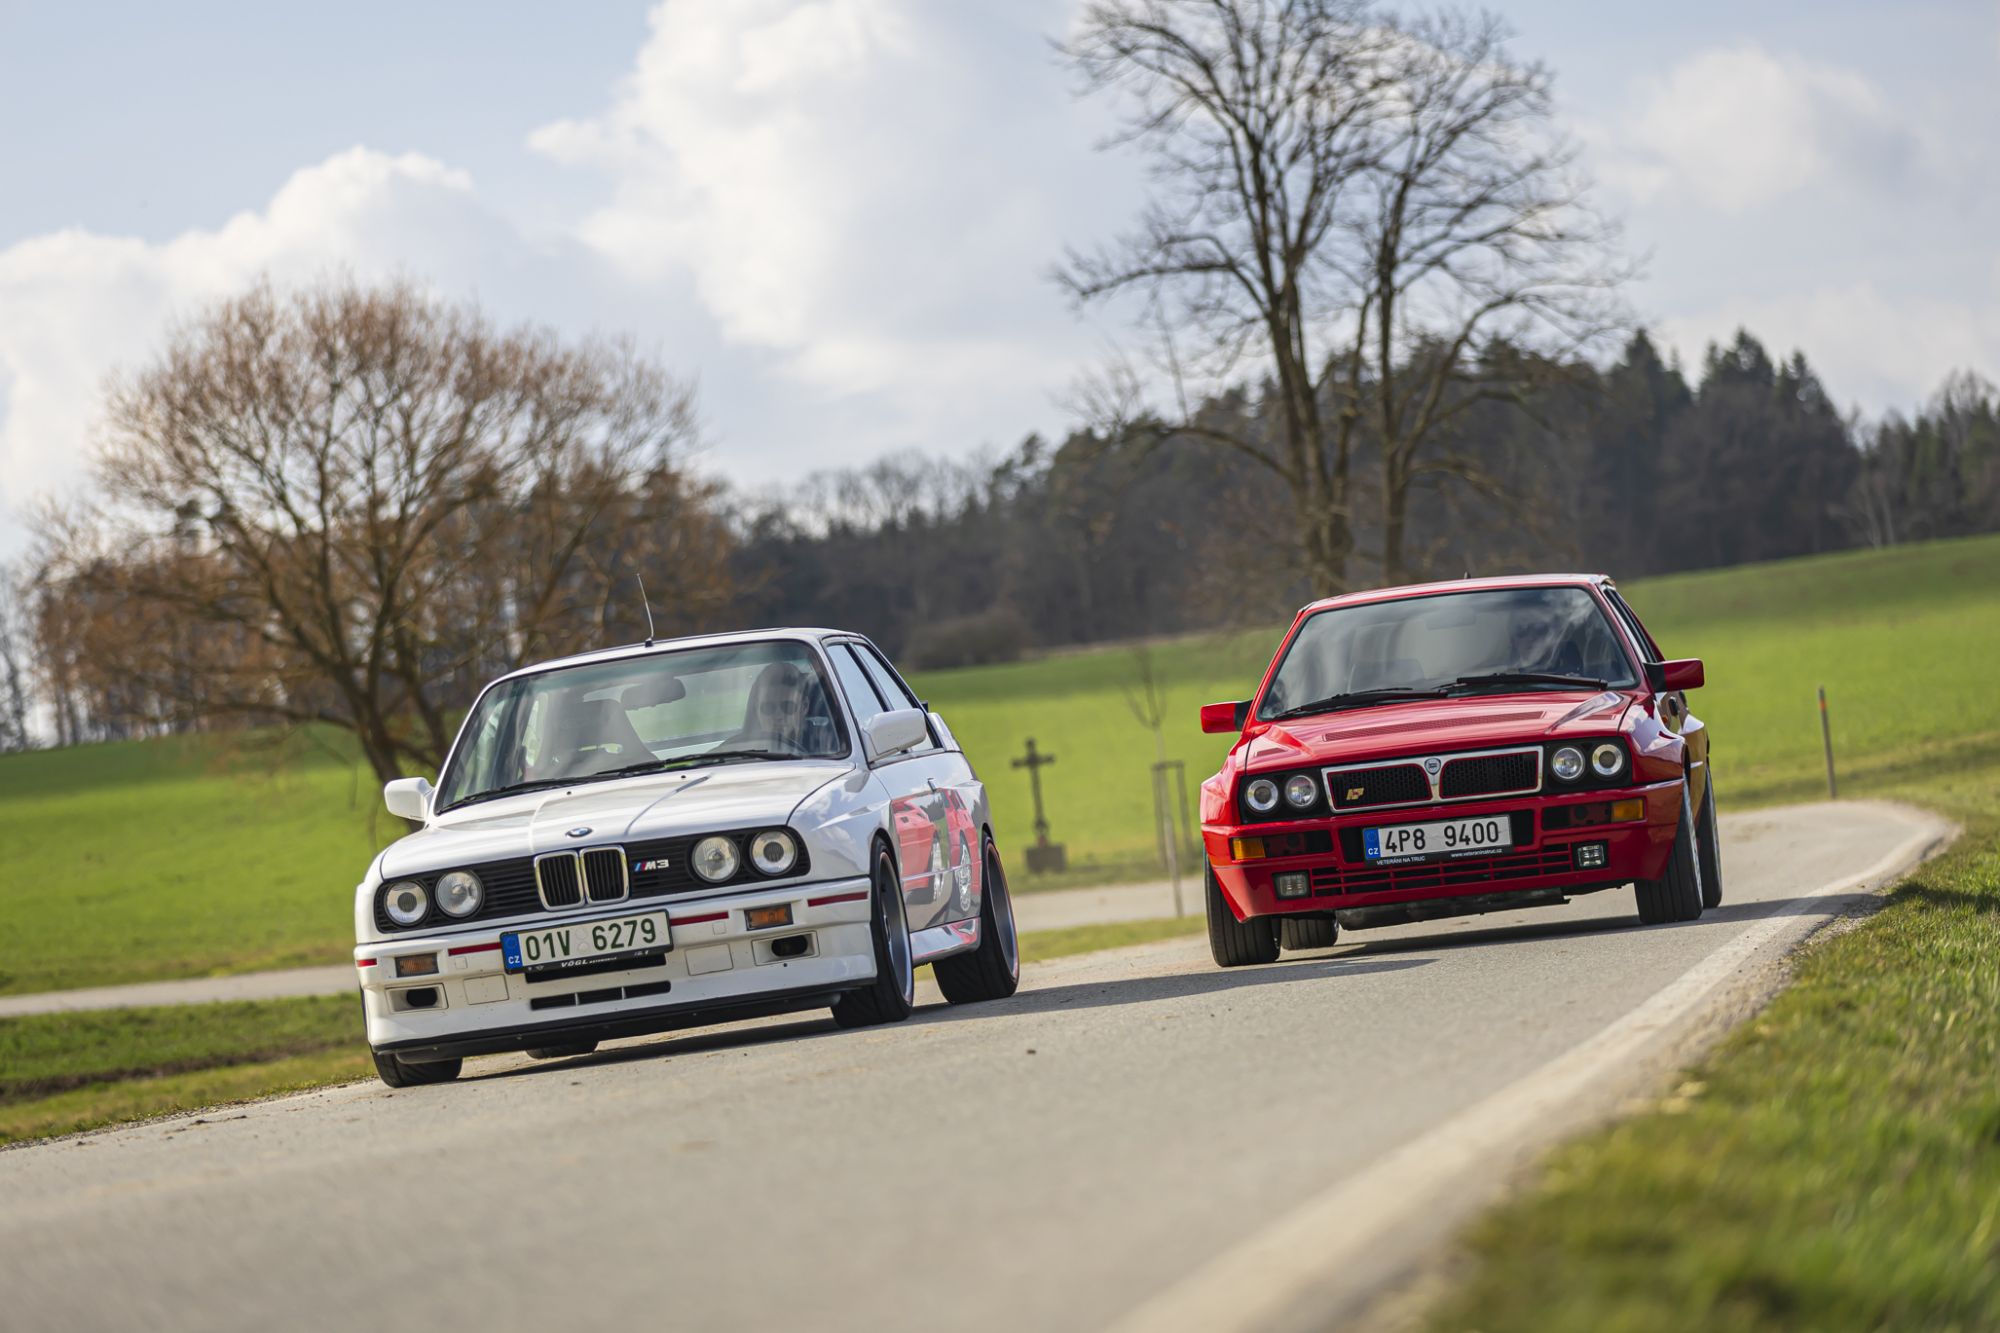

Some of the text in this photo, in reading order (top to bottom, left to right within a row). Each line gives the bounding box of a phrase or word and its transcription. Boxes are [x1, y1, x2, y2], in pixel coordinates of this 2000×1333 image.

[1385, 821, 1499, 853] 4P8 9400
[1368, 847, 1379, 856] CZ
[641, 859, 670, 872] M3
[525, 918, 656, 961] 01V 6279
[508, 955, 520, 965] CZ
[561, 958, 588, 968] VÖGL
